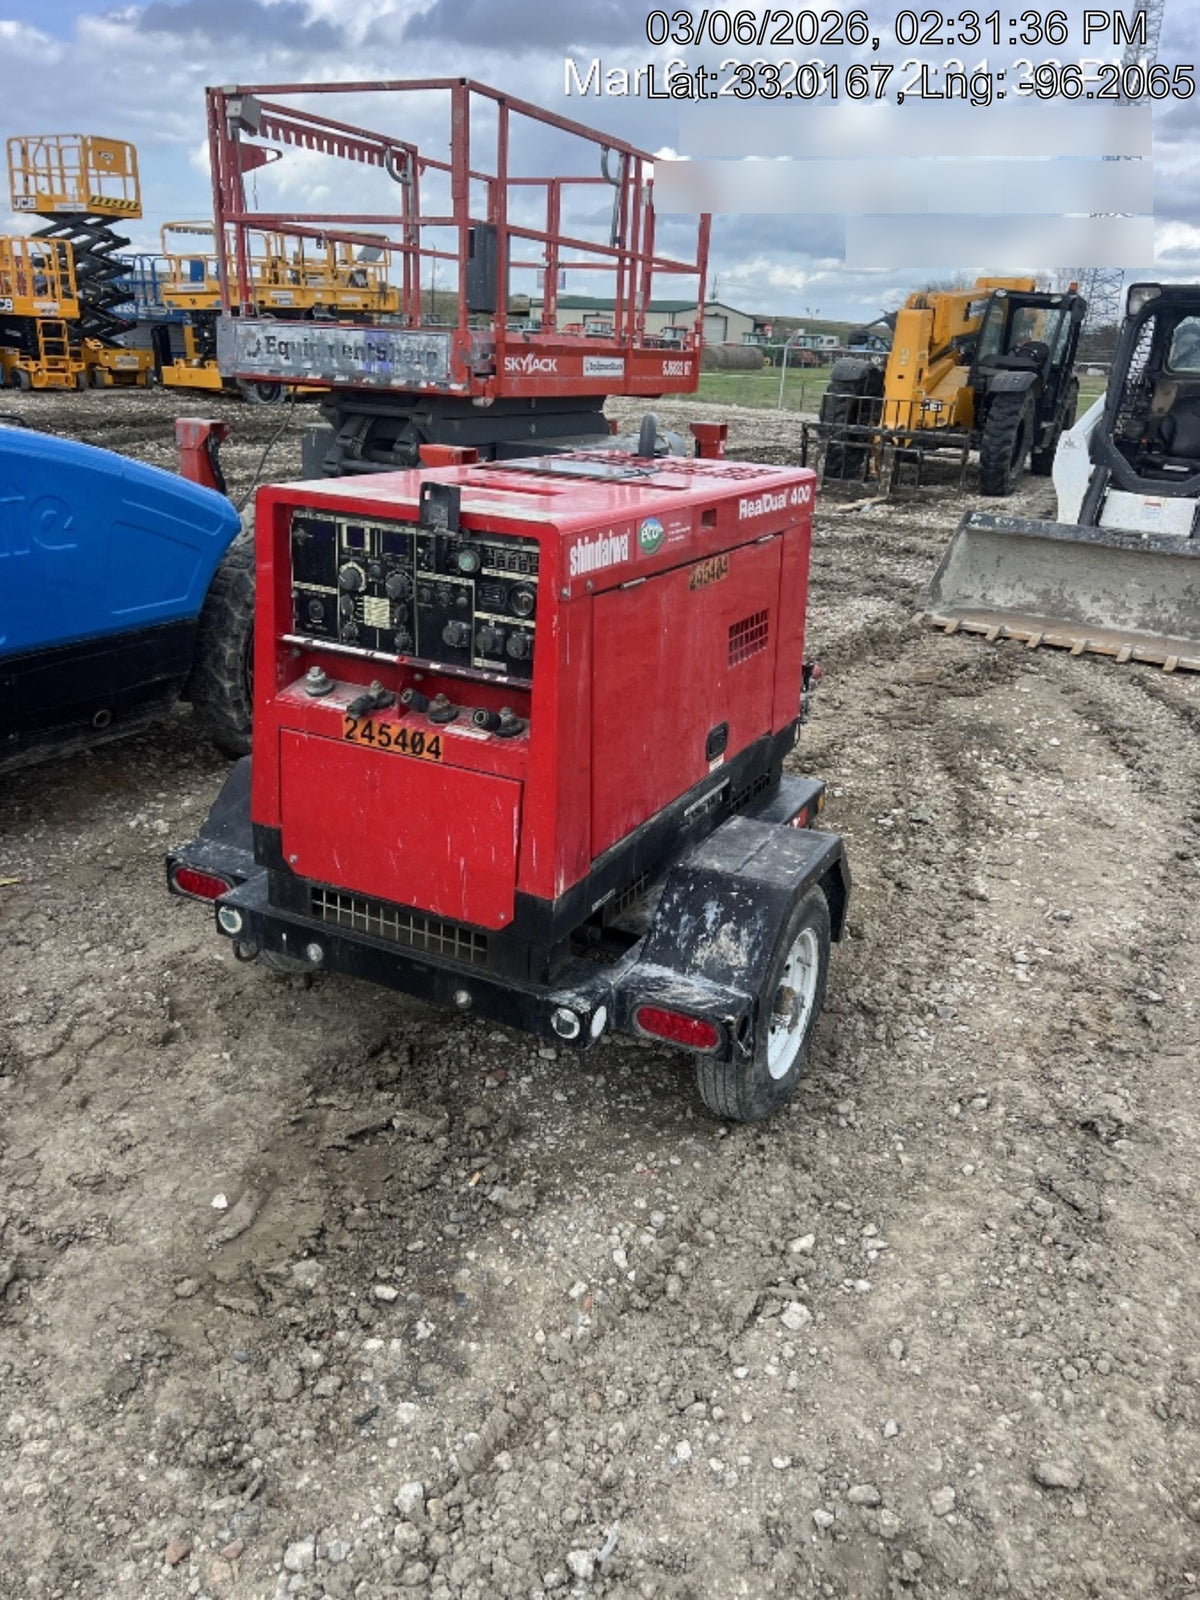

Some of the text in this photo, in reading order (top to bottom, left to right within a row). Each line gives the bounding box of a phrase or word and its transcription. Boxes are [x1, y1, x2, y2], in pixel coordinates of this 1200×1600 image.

[504, 353, 557, 374] SKYJACK
[791, 485, 811, 505] 400
[569, 528, 629, 577] shindaiwa
[343, 715, 442, 760] 245404
